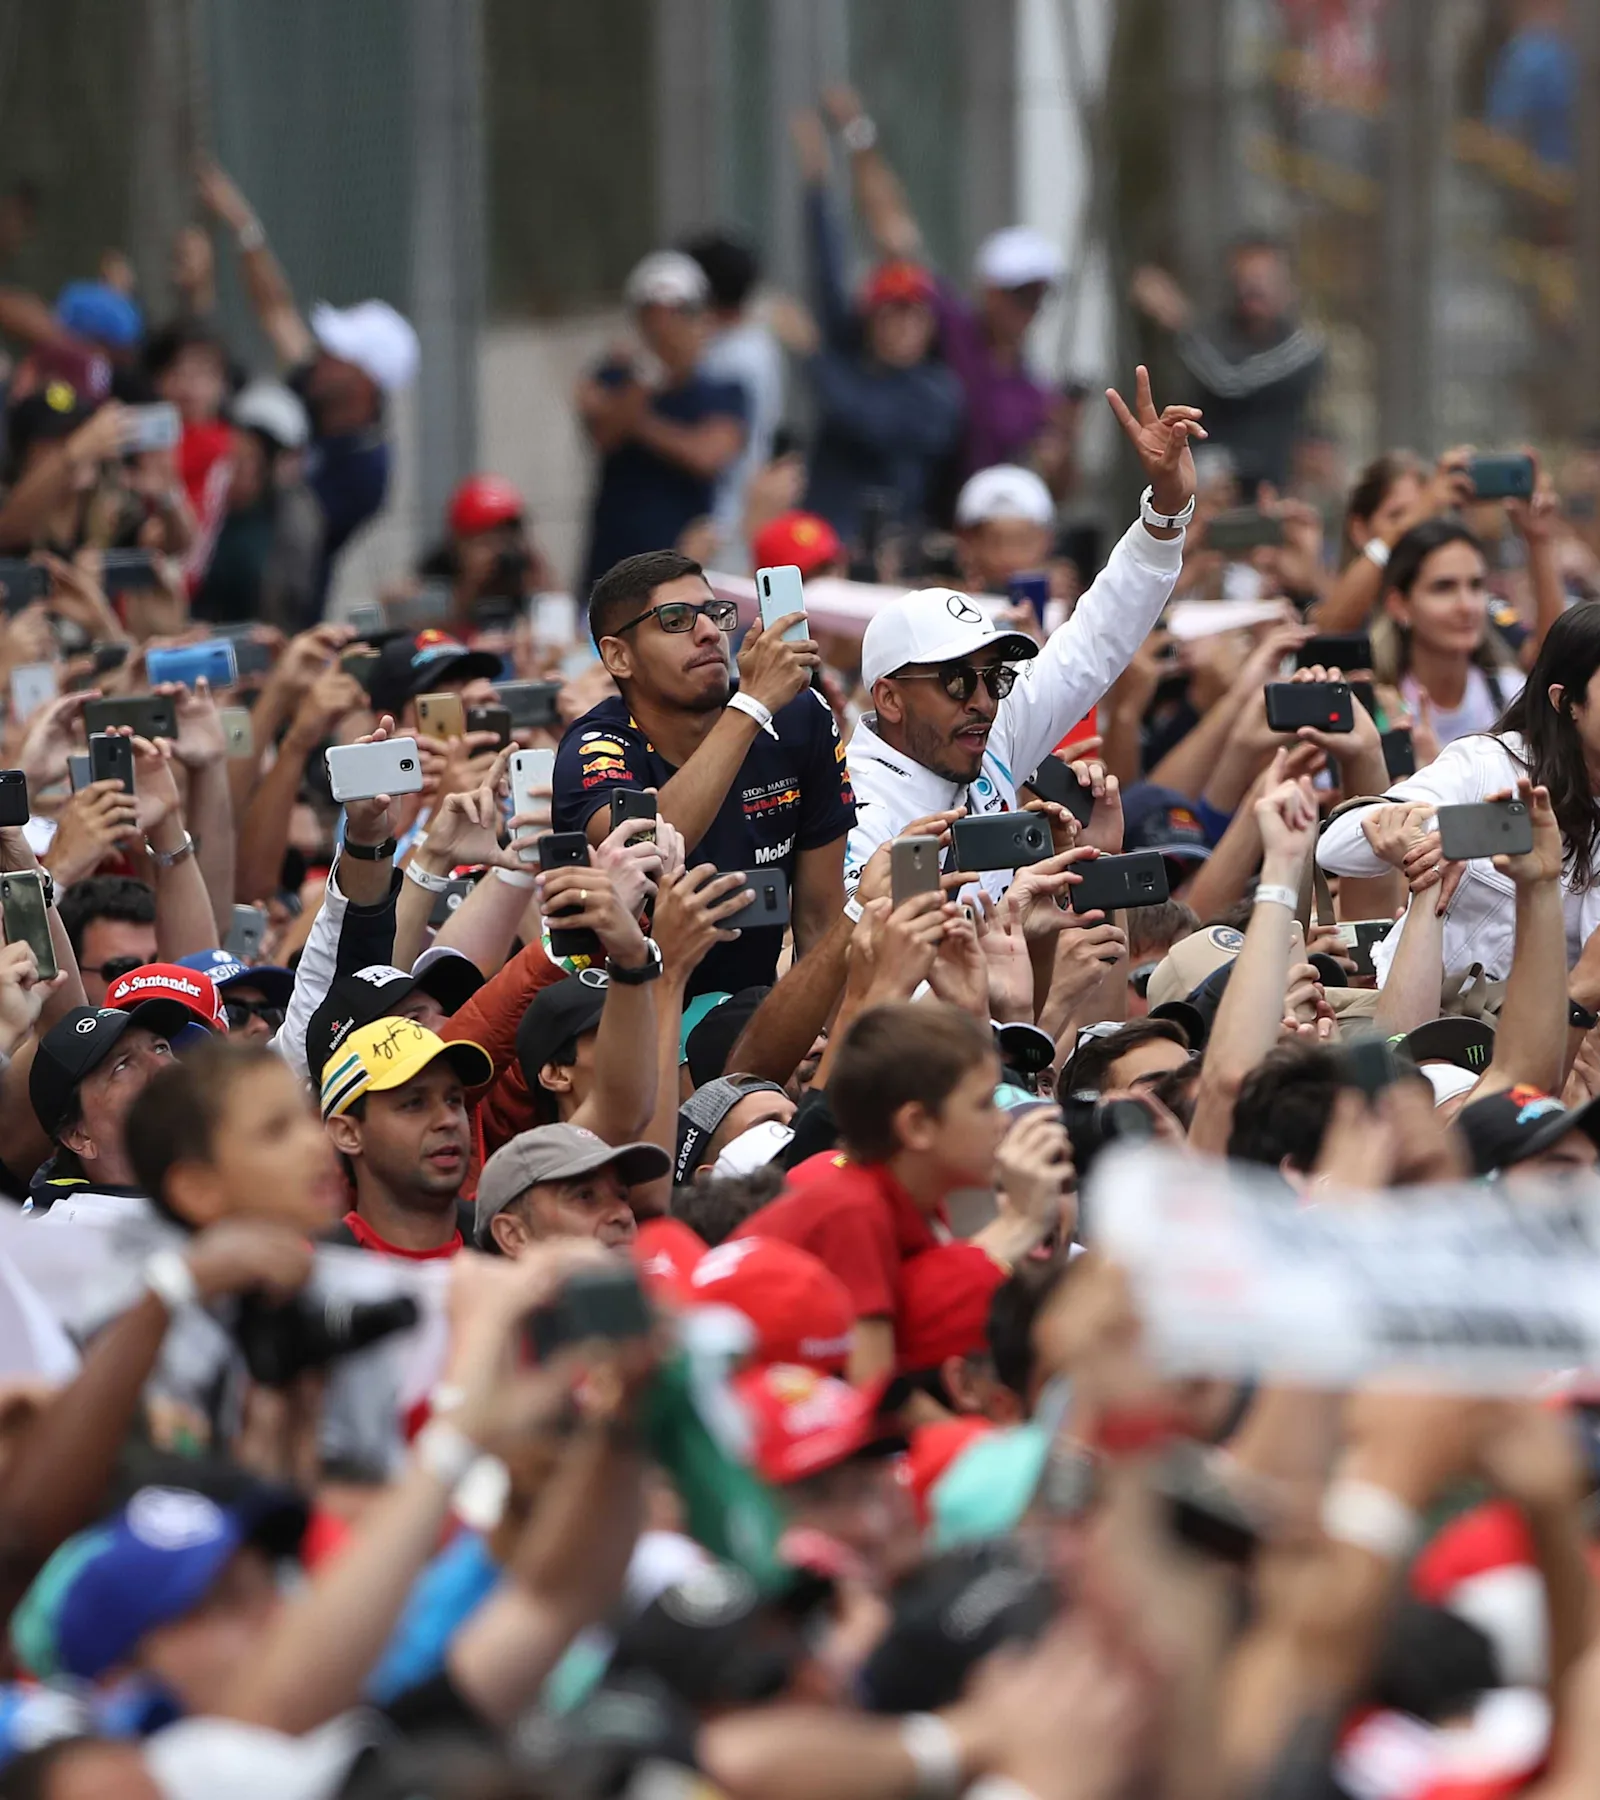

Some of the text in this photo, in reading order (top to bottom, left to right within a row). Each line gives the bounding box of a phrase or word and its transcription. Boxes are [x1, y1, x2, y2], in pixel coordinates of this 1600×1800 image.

[582, 769, 634, 790] Red Bull
[743, 796, 778, 813] Red Bull
[755, 838, 791, 865] Mobil
[131, 975, 202, 998] Santander
[329, 1016, 355, 1051] Heineken
[677, 1127, 699, 1170] exact
